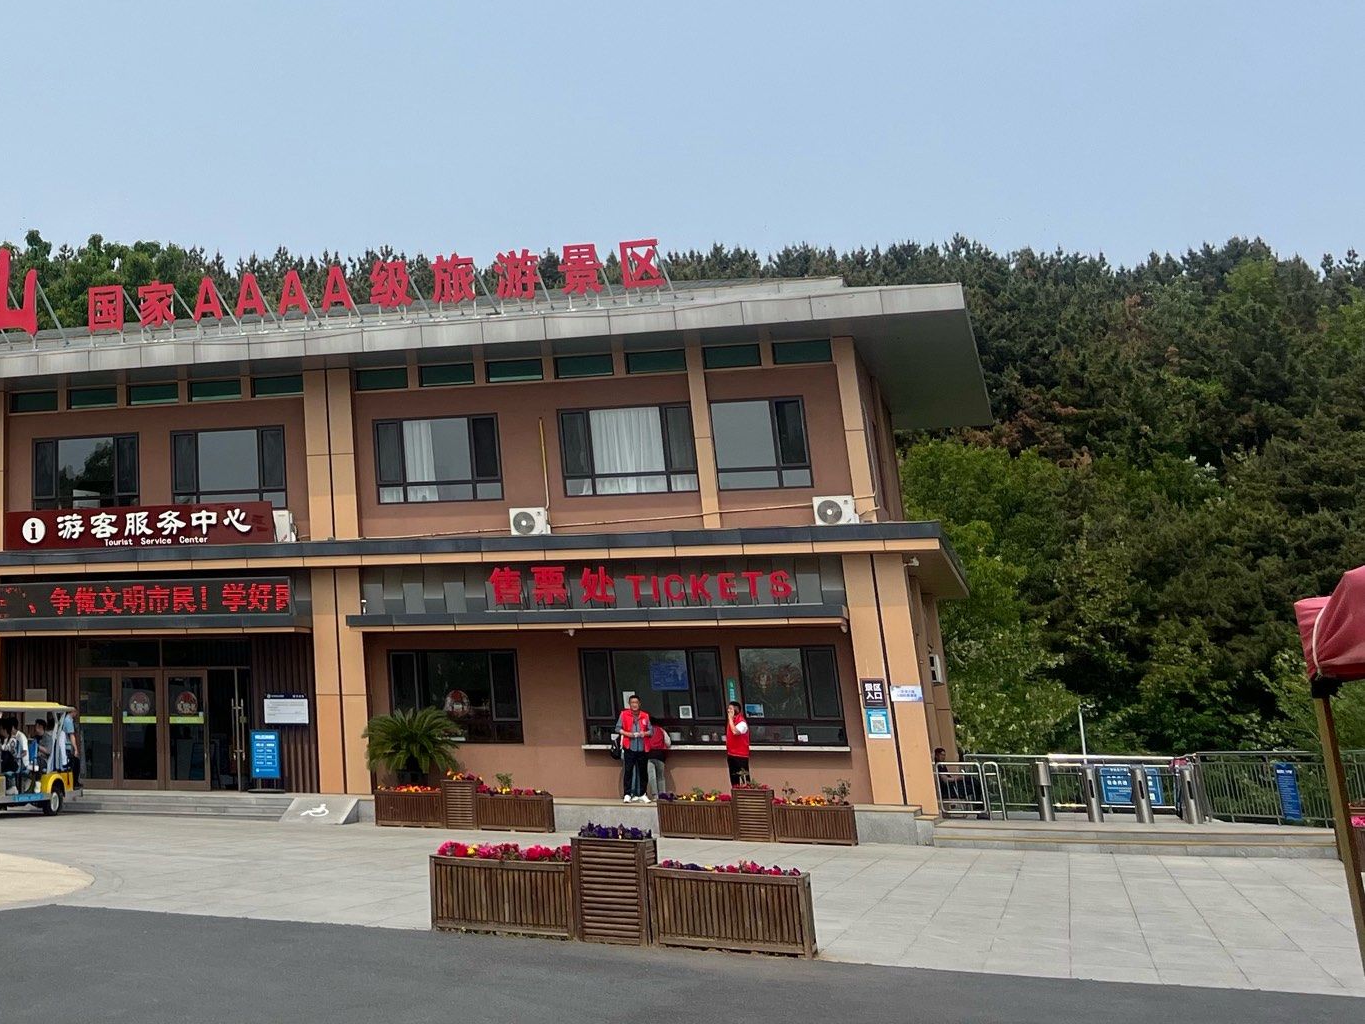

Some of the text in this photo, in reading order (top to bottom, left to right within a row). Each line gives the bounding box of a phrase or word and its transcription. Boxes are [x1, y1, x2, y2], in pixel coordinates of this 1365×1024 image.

[88, 239, 666, 333] 国家AAAA级旅游景区
[56, 508, 252, 540] 游客服务中心
[104, 536, 209, 546] Tourist Service Center
[489, 566, 793, 605] 售票处 TICKETS
[866, 691, 883, 700] 入口
